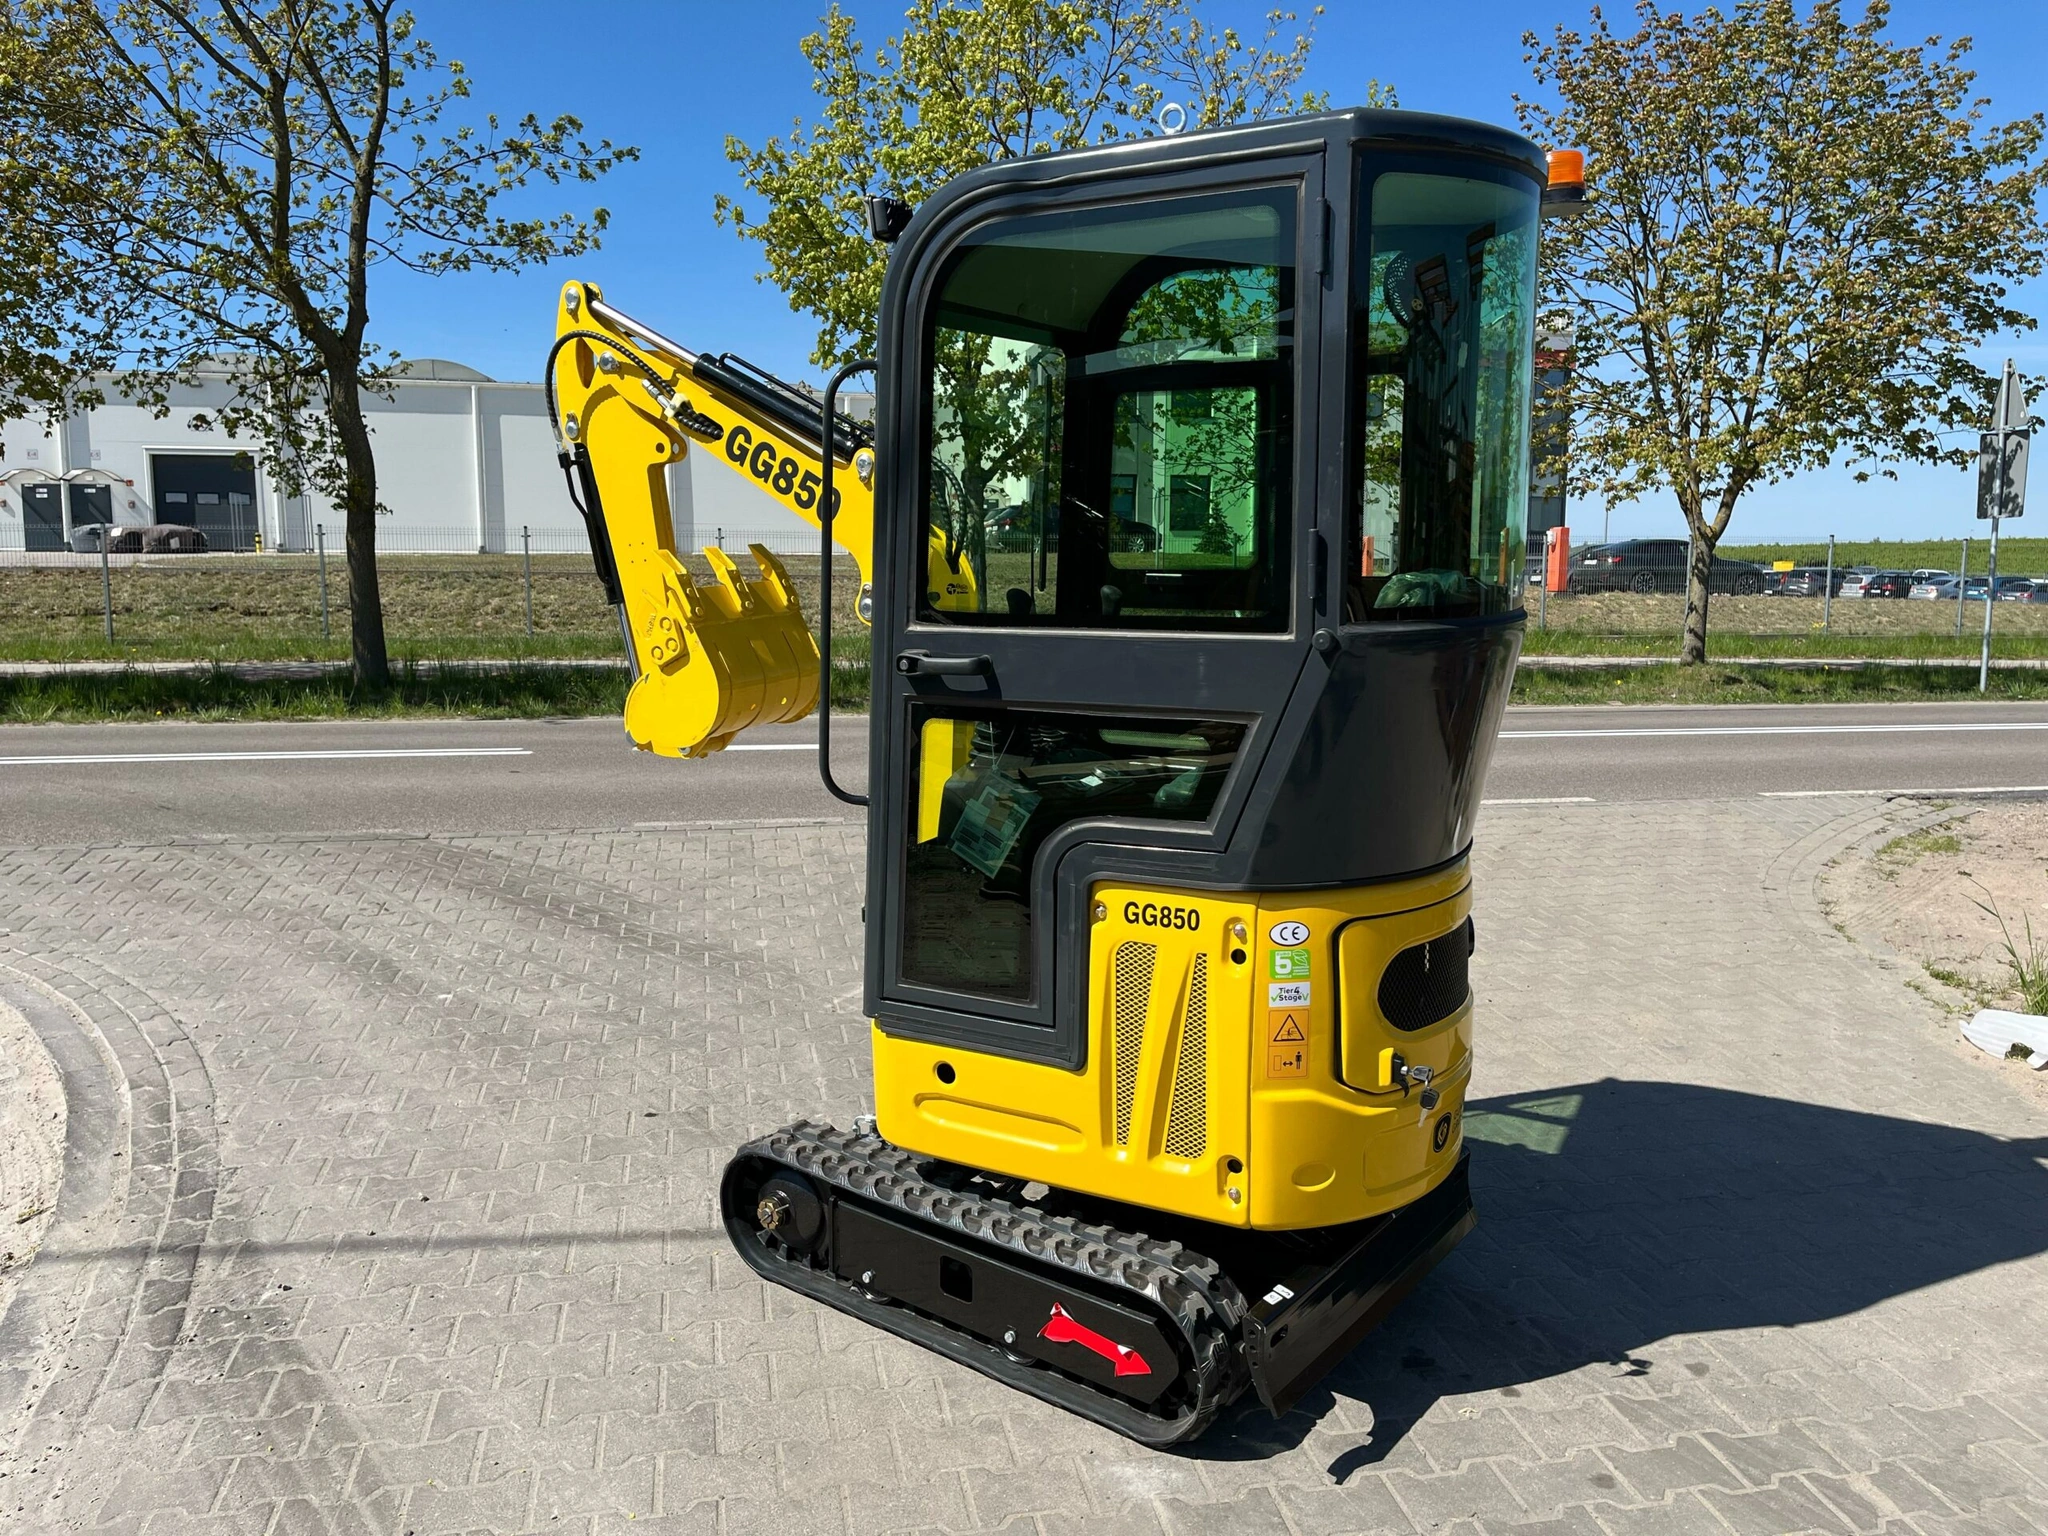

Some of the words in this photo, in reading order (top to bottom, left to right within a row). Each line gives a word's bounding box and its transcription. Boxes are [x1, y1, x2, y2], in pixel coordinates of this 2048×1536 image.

[725, 426, 841, 523] GG850
[1124, 901, 1200, 931] GG850
[1280, 926, 1300, 941] CE
